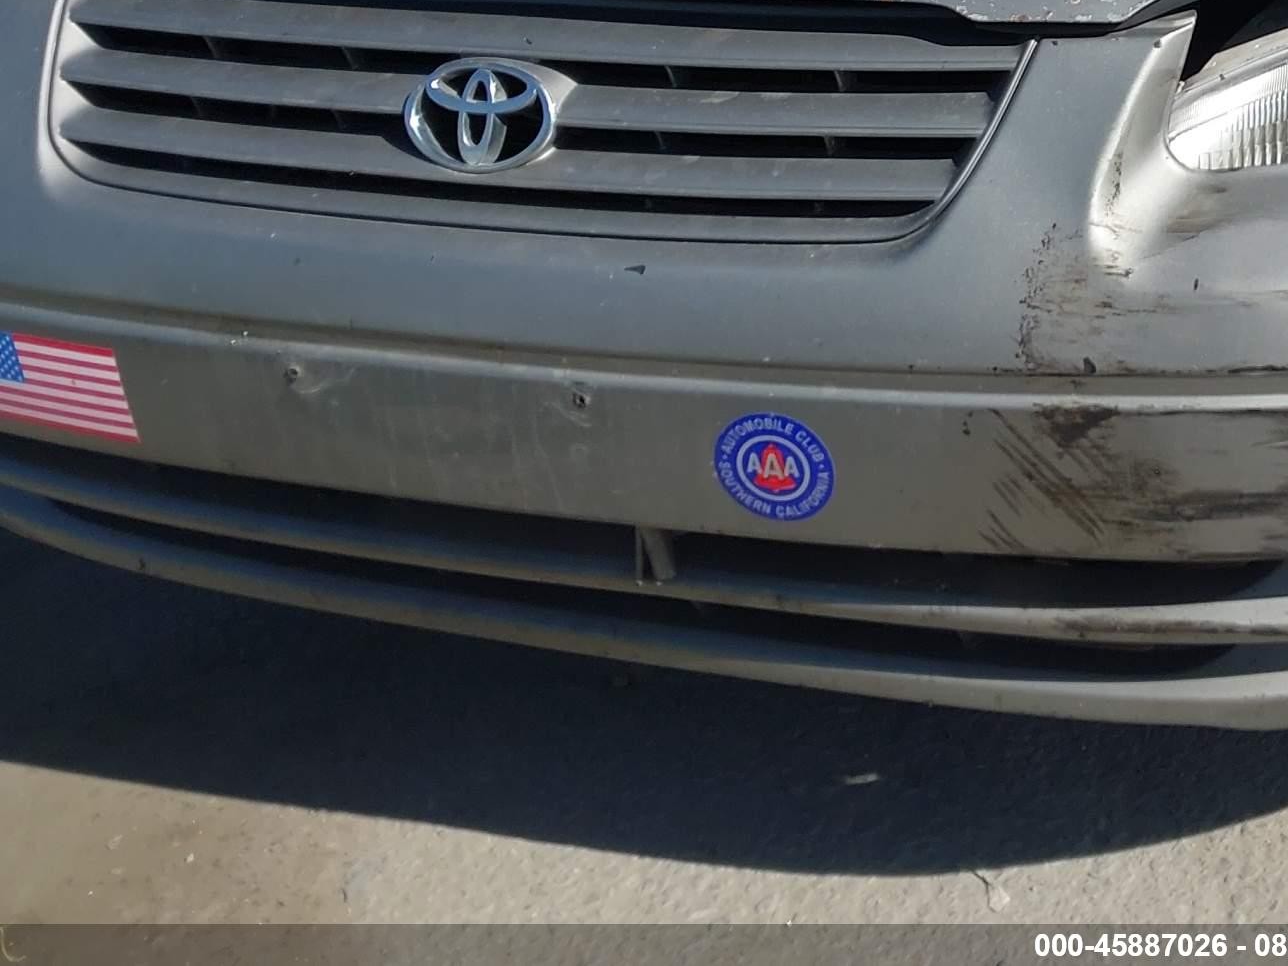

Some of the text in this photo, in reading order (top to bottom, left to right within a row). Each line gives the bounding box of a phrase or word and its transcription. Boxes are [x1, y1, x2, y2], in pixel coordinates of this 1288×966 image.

[721, 417, 825, 462] AUTOMOBILE CLUB
[718, 461, 772, 515] SOUTHERN
[746, 452, 800, 480] AAA
